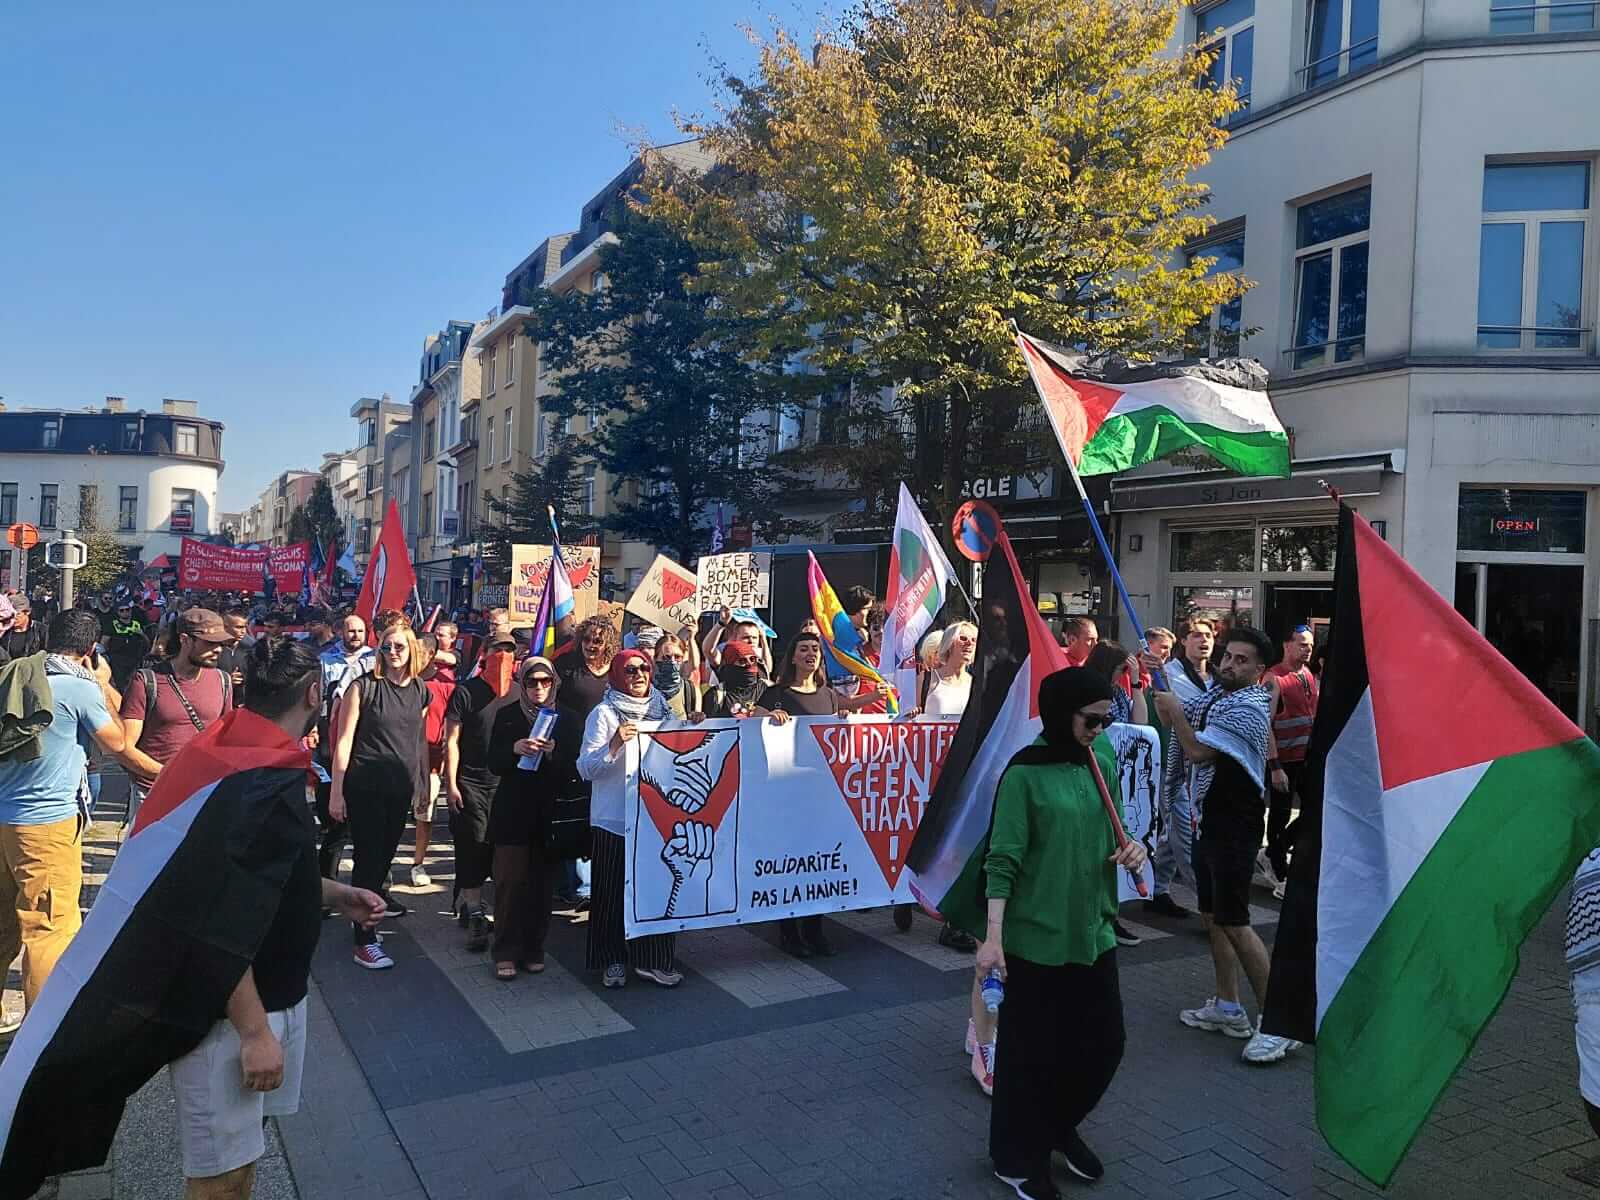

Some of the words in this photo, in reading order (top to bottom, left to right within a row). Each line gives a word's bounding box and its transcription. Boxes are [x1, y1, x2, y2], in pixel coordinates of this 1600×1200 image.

[1226, 486, 1262, 501] Jan
[1496, 520, 1536, 530] OPEN
[706, 553, 759, 569] MEER
[707, 567, 760, 584] BOMEN
[700, 580, 759, 596] MINDER
[645, 591, 666, 610] VAN
[701, 594, 764, 610] BAZEN
[843, 761, 932, 799] GEEN
[861, 793, 932, 832] HAAT
[889, 835, 899, 873] !
[751, 888, 778, 908] PAS
[783, 885, 802, 905] LA
